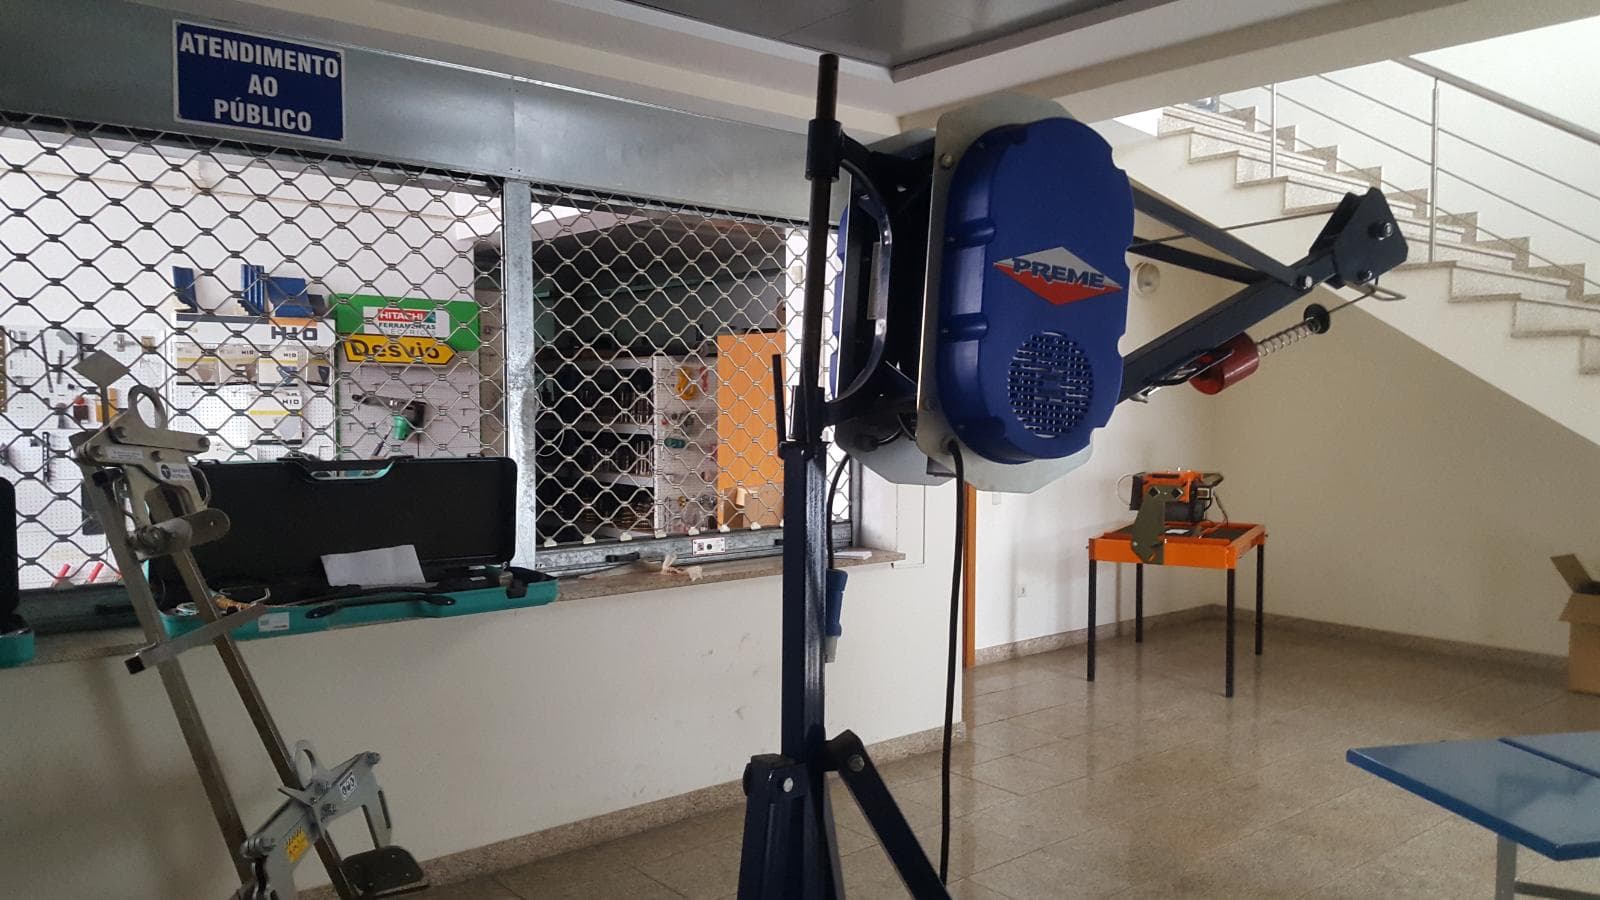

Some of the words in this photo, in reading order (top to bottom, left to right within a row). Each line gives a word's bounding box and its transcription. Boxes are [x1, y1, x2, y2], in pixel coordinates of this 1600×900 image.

[180, 31, 339, 78] ATENDIMENTO
[248, 74, 278, 97] AO
[214, 97, 312, 132] PÚBLICO
[1012, 257, 1105, 290] PREME
[380, 311, 423, 321] HITACHI
[350, 340, 440, 359] Desvio
